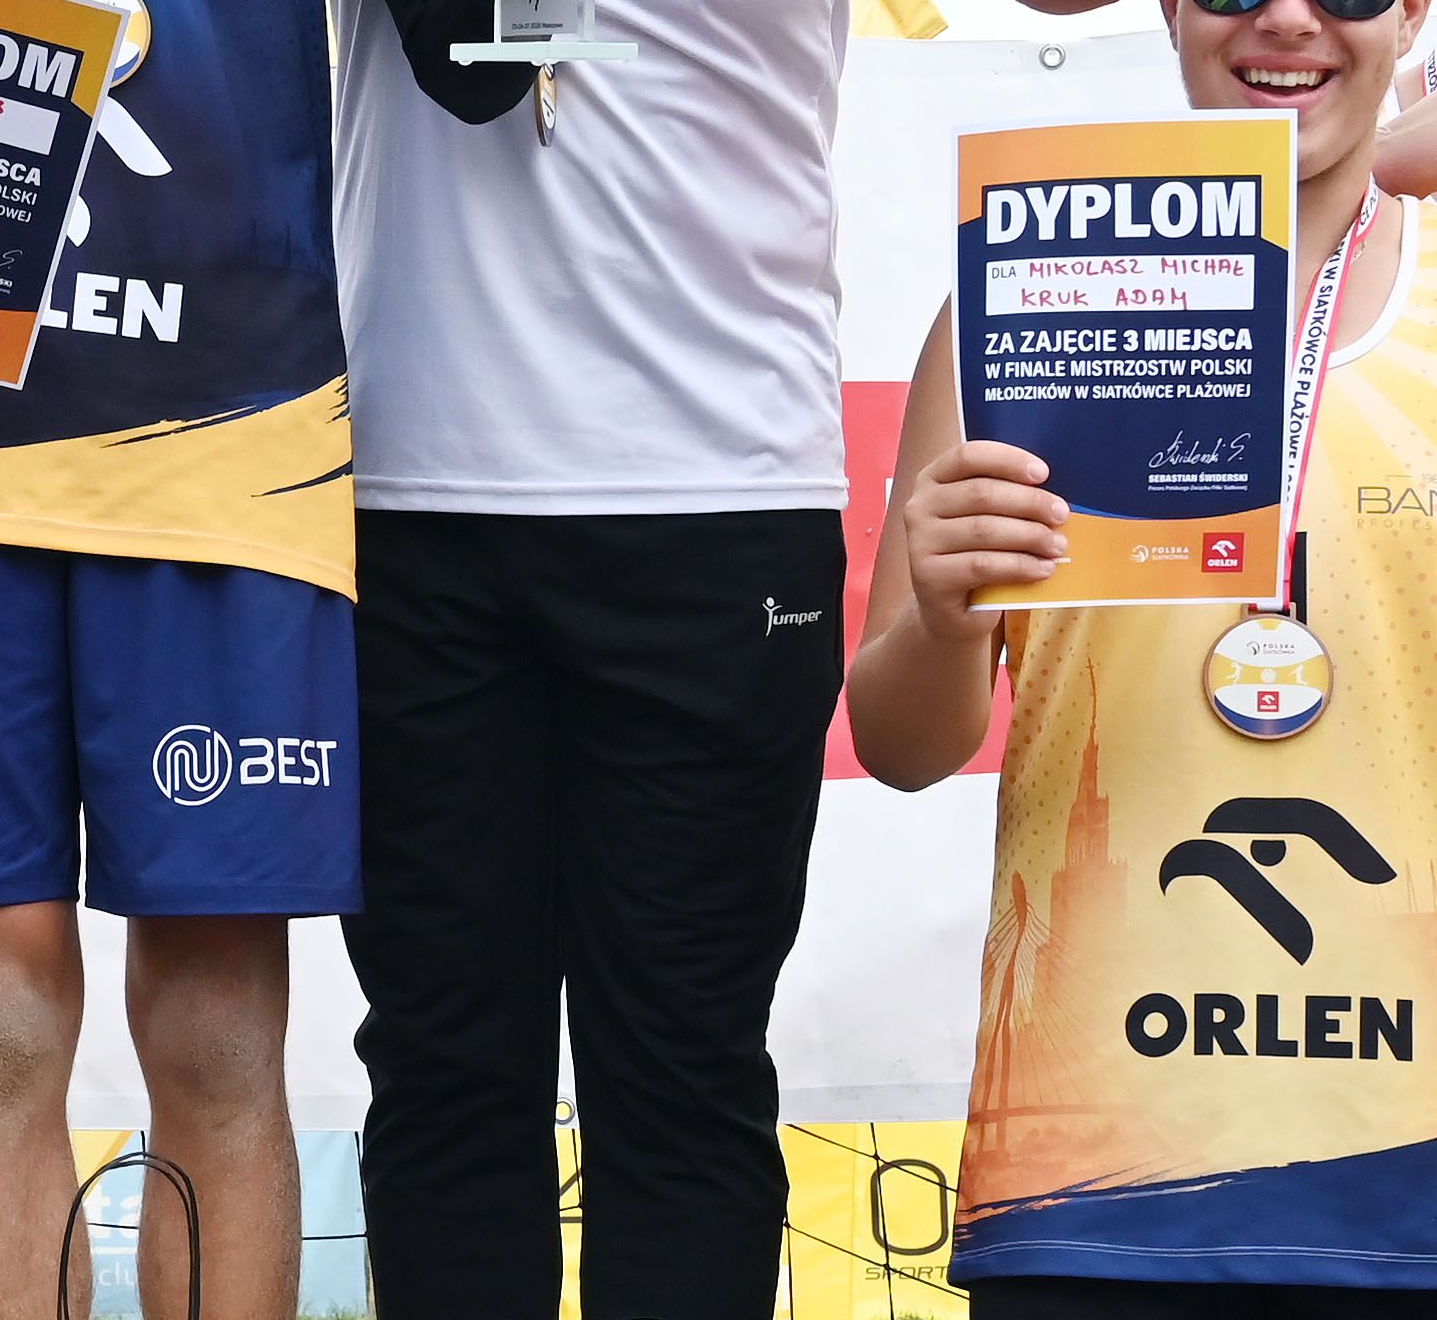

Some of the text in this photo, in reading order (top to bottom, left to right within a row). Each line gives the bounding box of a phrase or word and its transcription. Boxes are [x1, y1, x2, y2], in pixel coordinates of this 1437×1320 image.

[985, 180, 1256, 245] DYPLOM
[991, 266, 1016, 279] DLA
[1020, 284, 1188, 313] KRUK ADAM
[984, 324, 1253, 358] ZA ZAJĘCIE 3 MIEJSCA
[1298, 283, 1333, 377] SIATKÓWCE
[985, 355, 1252, 380] W FINALE MISTRZOSTW POLSKI
[984, 378, 1250, 403] MŁODZIKÓW W SIATKÓWCE PLAŻOWEJ
[1148, 469, 1248, 484] SEBASTIAN ŚWIDERSKI
[238, 738, 337, 786] BEST
[1124, 992, 1414, 1062] ORLEN
